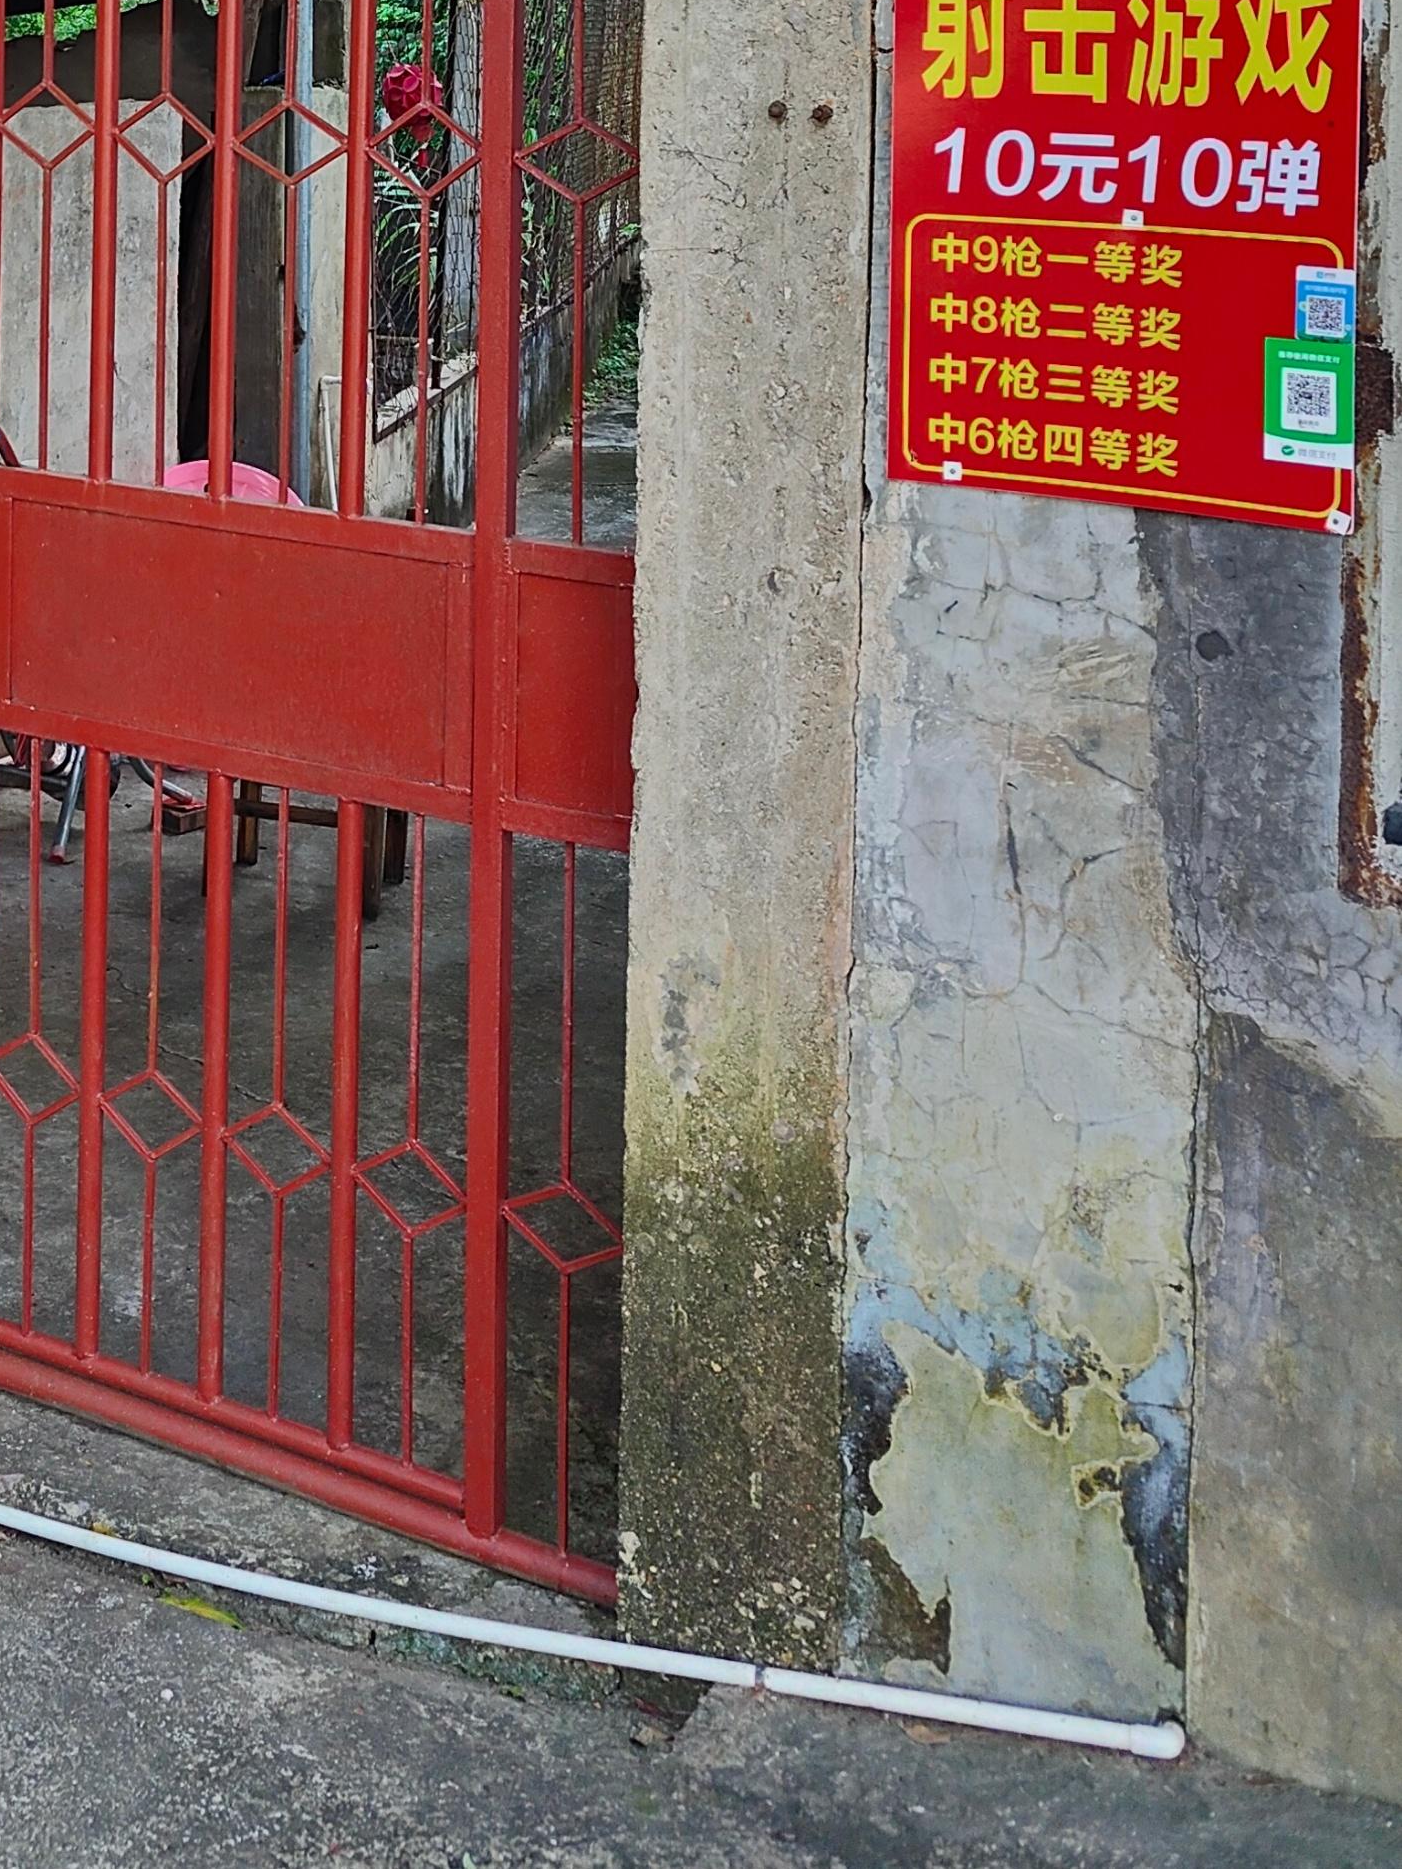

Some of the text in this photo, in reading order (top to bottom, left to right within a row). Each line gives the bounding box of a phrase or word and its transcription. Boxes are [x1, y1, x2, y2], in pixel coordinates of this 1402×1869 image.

[933, 126, 1321, 217] 10元10弹
[930, 232, 1183, 289] 中9枪一等奖
[929, 291, 1182, 351] 中8枪二等奖
[928, 352, 1180, 415] 中7枪三等奖
[927, 411, 1179, 479] 中6枪四等奖
